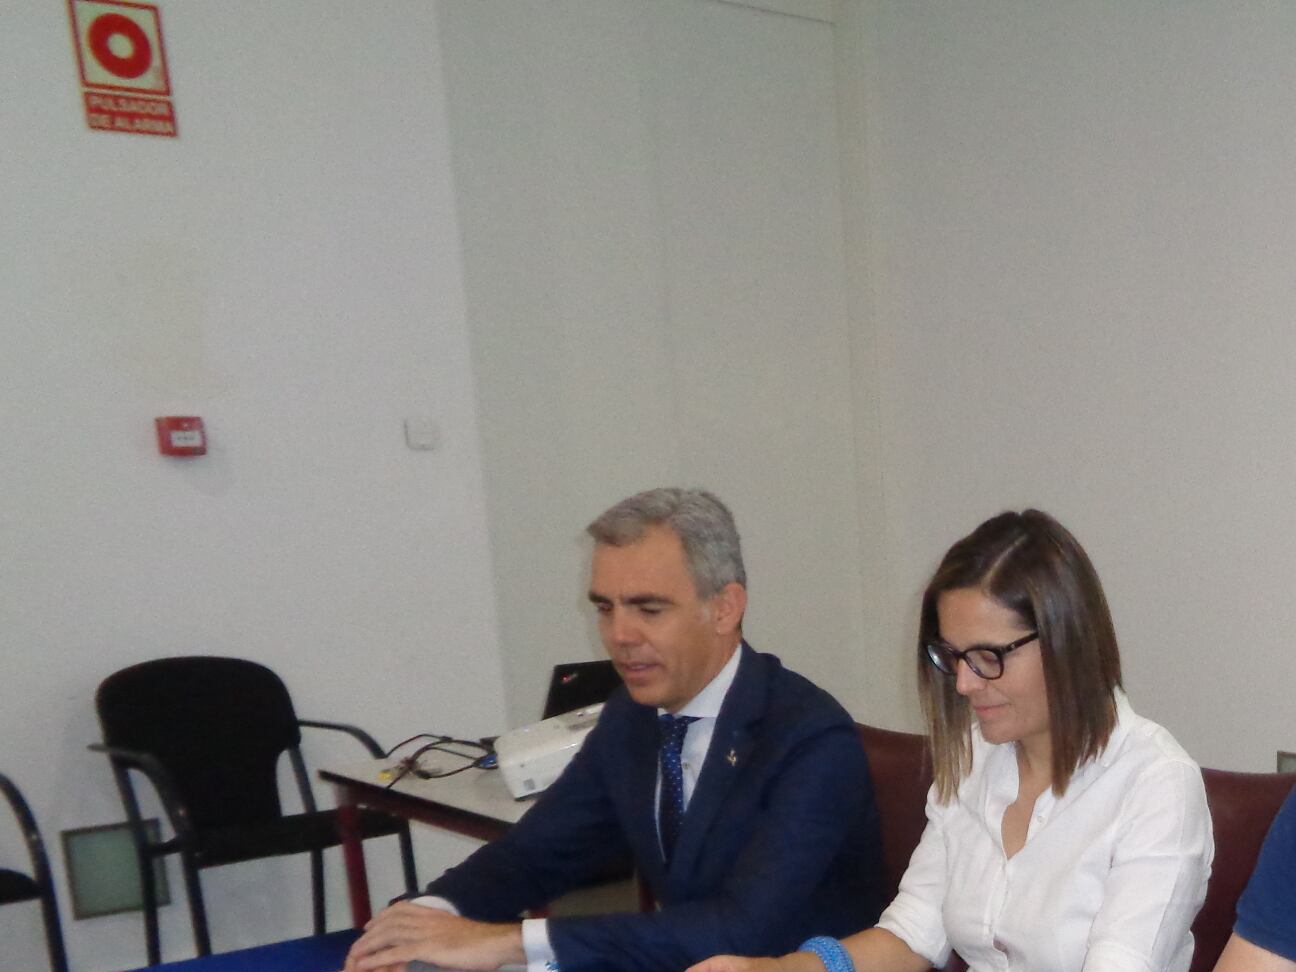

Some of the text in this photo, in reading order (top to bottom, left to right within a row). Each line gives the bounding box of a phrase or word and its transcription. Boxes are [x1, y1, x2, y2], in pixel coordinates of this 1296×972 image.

[90, 96, 167, 114] PULSADOR
[90, 113, 173, 132] DE ALARMA
